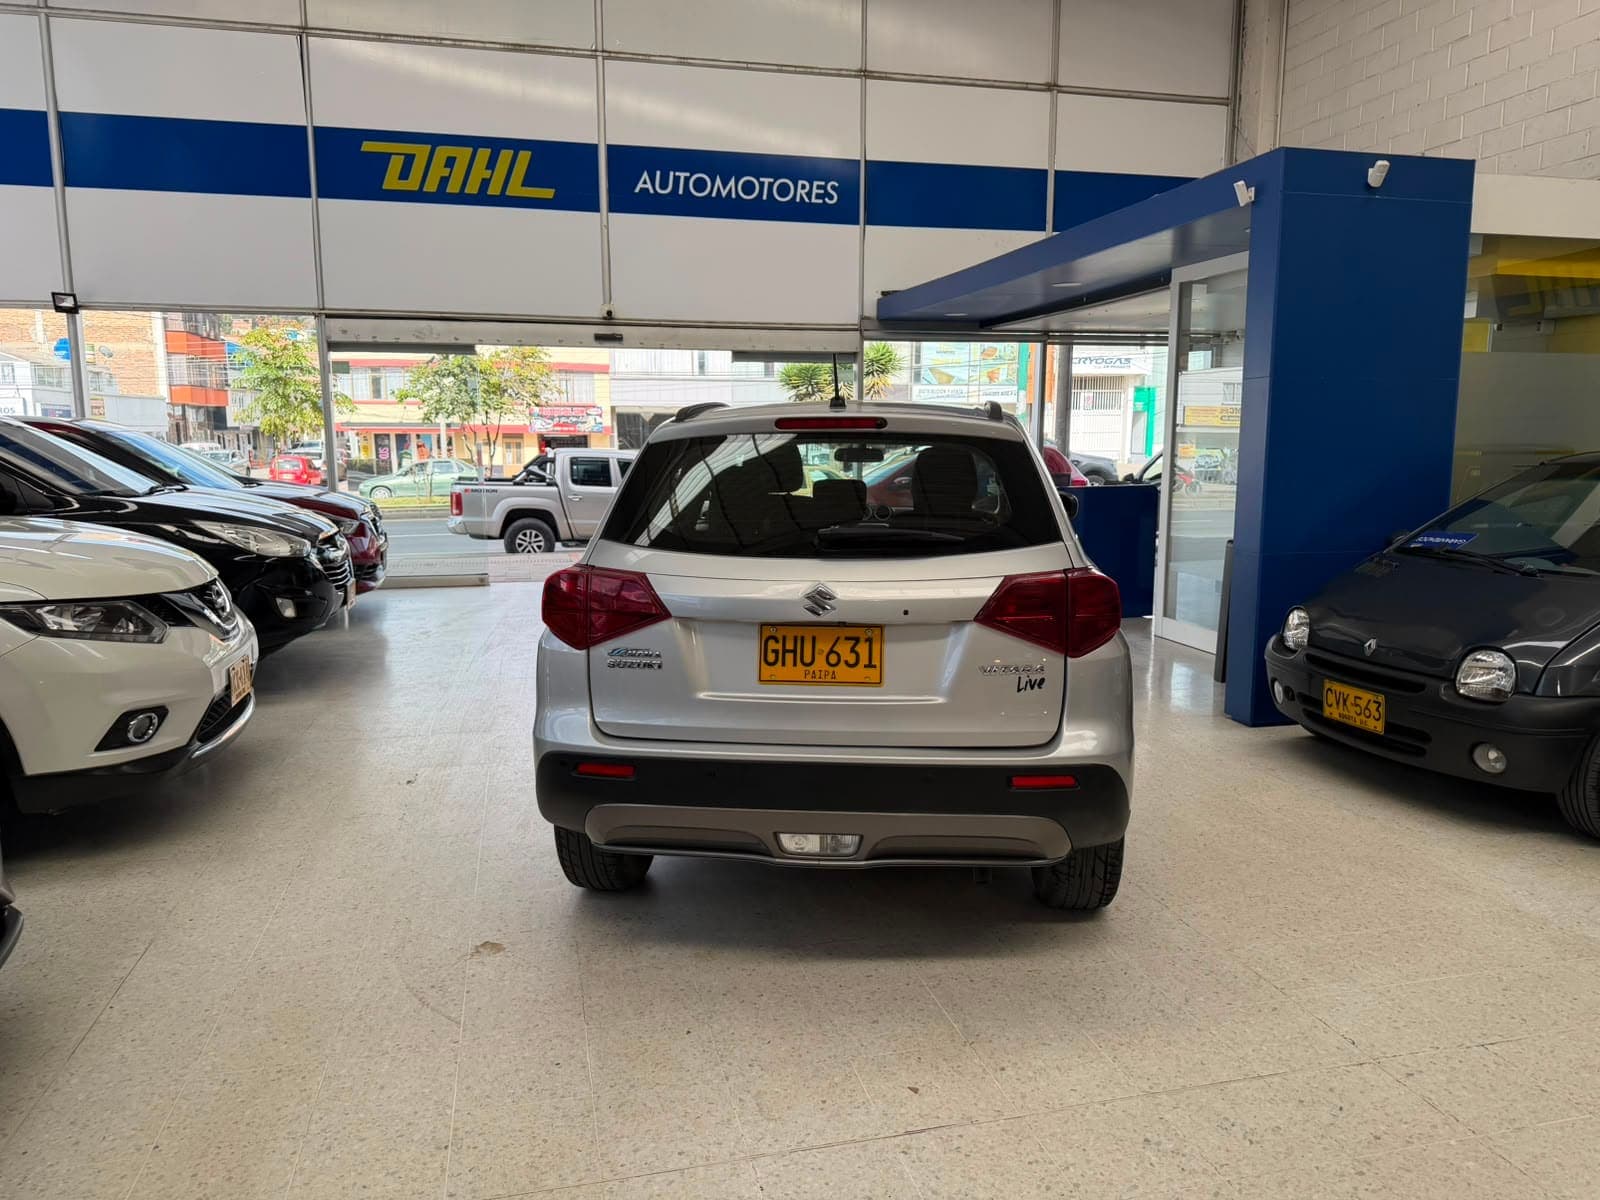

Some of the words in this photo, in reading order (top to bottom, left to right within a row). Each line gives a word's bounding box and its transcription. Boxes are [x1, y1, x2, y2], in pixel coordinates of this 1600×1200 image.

[361, 141, 556, 199] DAHL
[634, 169, 840, 205] AUTOMOTORES
[608, 659, 662, 670] SUZUKI
[763, 635, 816, 667] GHU
[825, 636, 877, 669] 631
[804, 670, 837, 680] PAIPA
[1017, 675, 1046, 693] Live
[1326, 688, 1349, 713] CVK
[1353, 696, 1381, 722] 563
